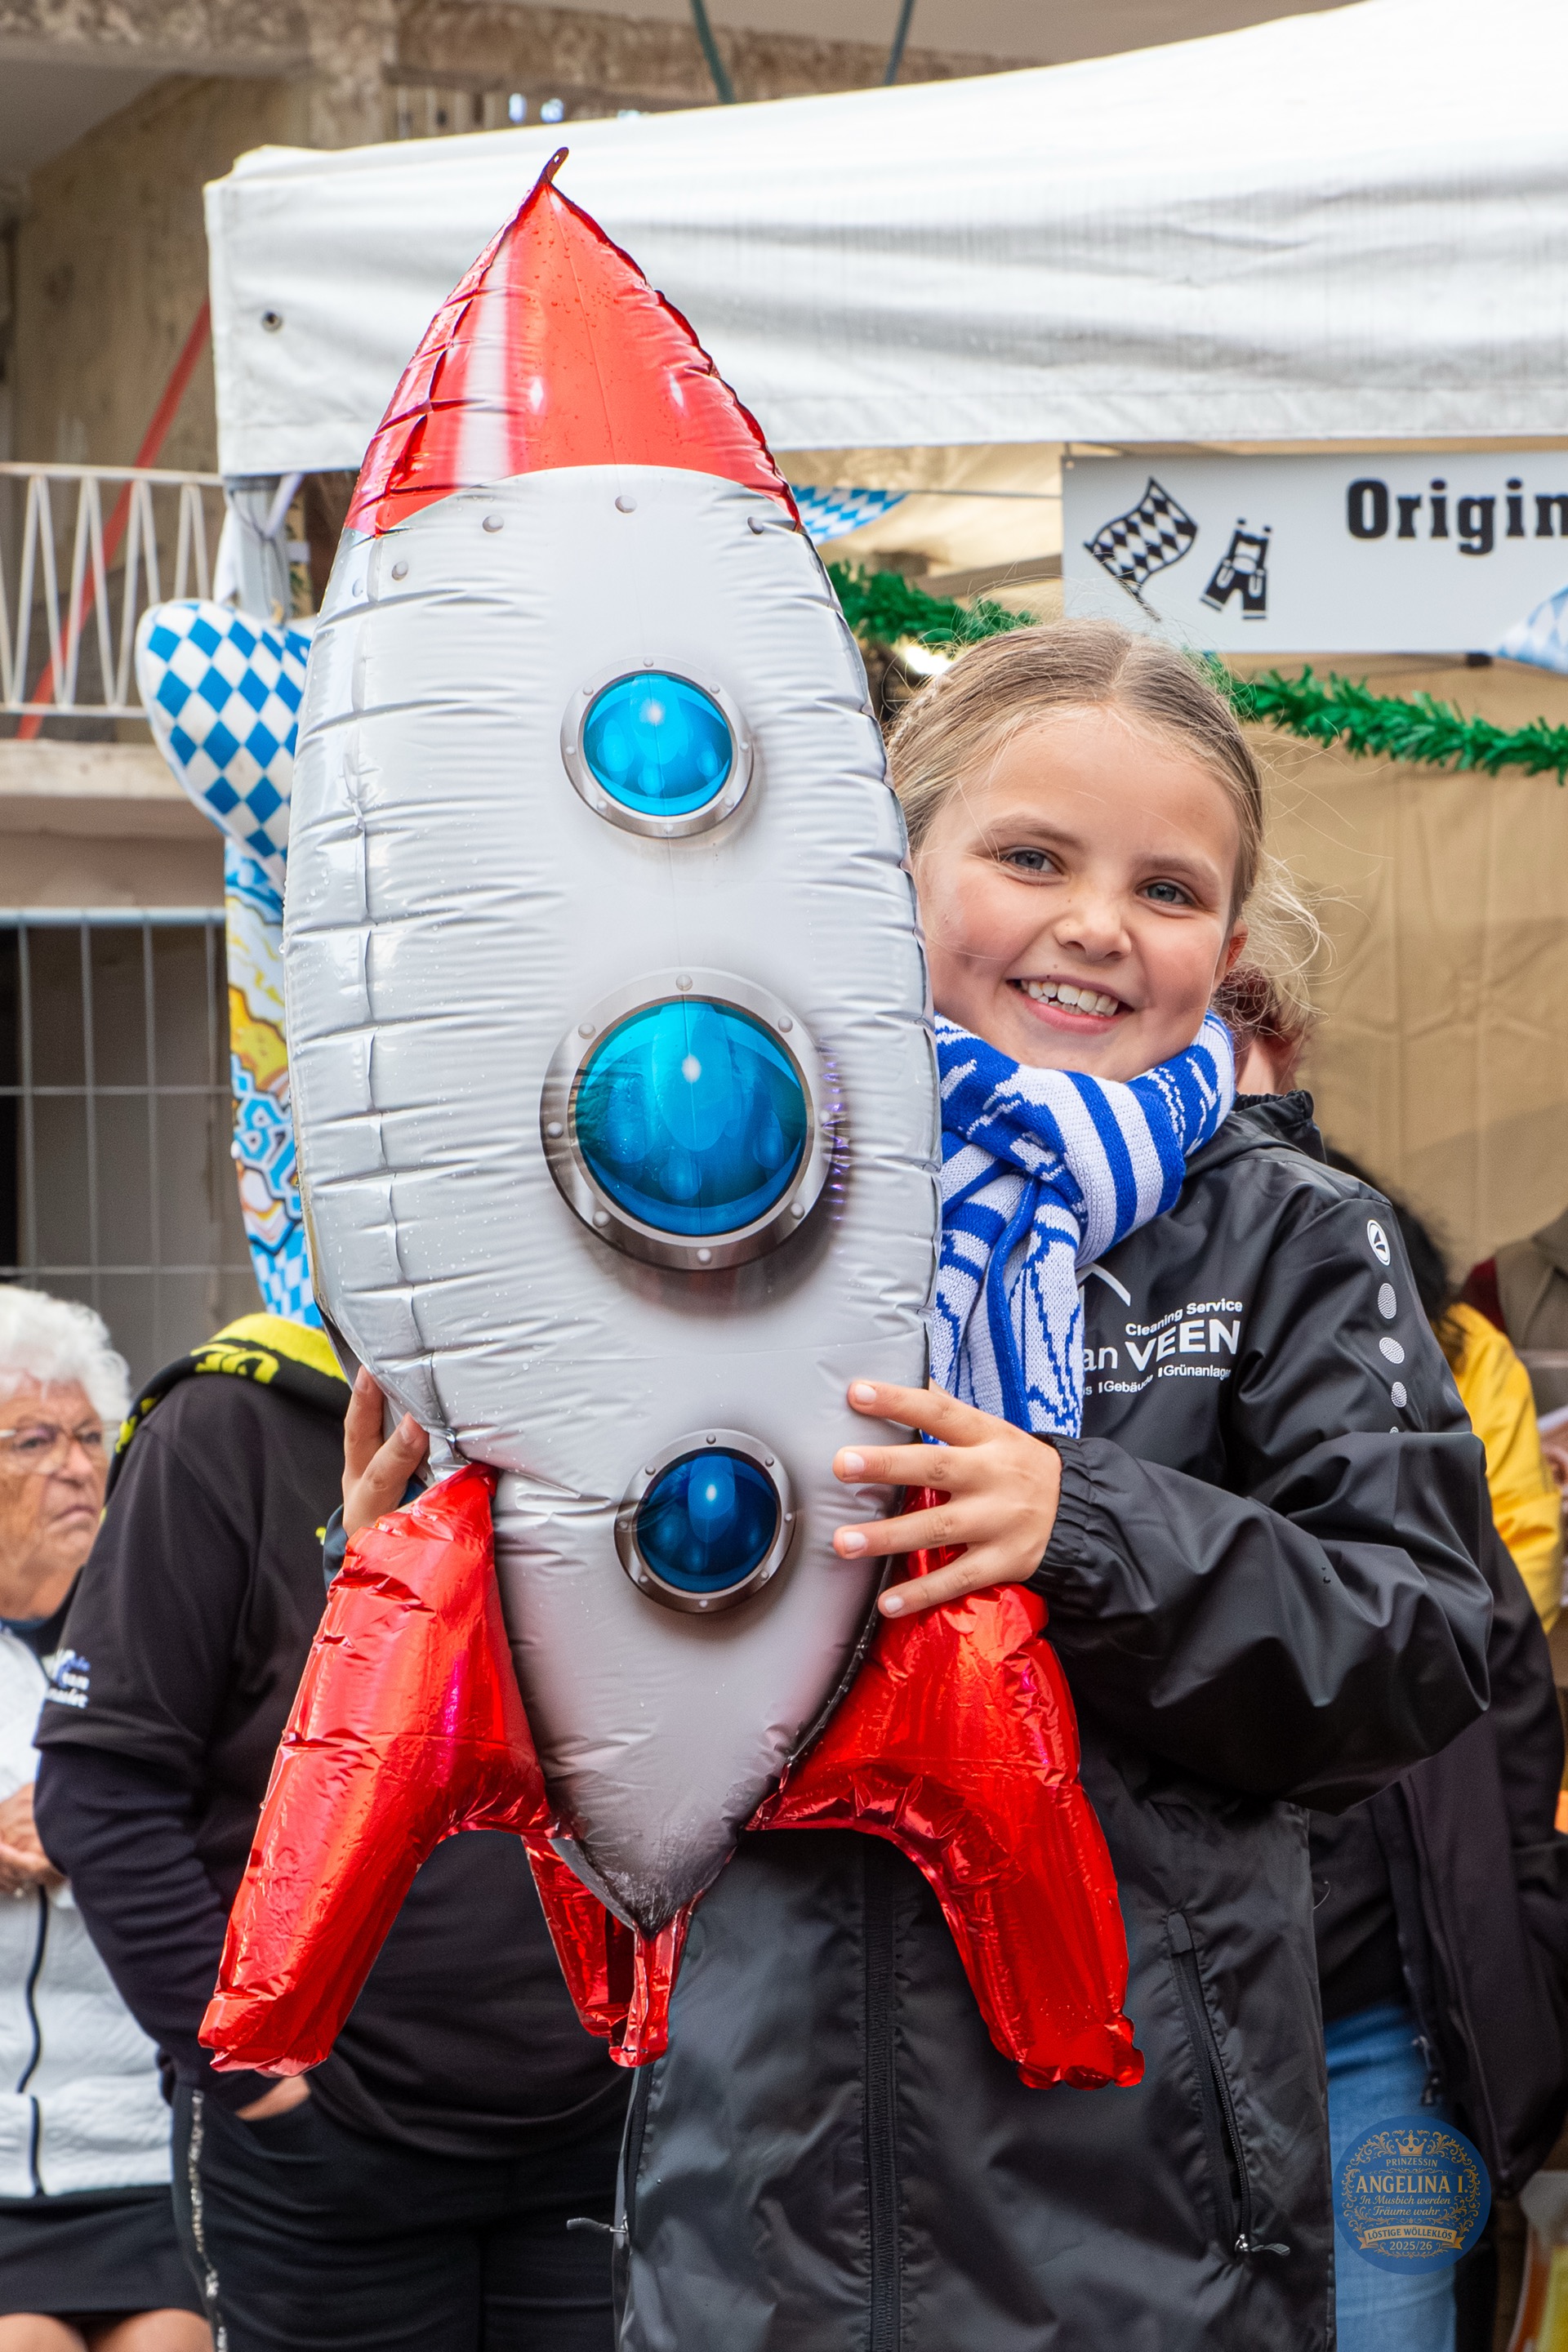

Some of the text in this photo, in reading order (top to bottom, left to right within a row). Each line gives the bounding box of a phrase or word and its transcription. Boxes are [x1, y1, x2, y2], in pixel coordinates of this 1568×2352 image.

[1347, 477, 1568, 556] Origin
[1125, 1298, 1243, 1336] Cleaning Service
[1125, 1318, 1241, 1372] VEEN
